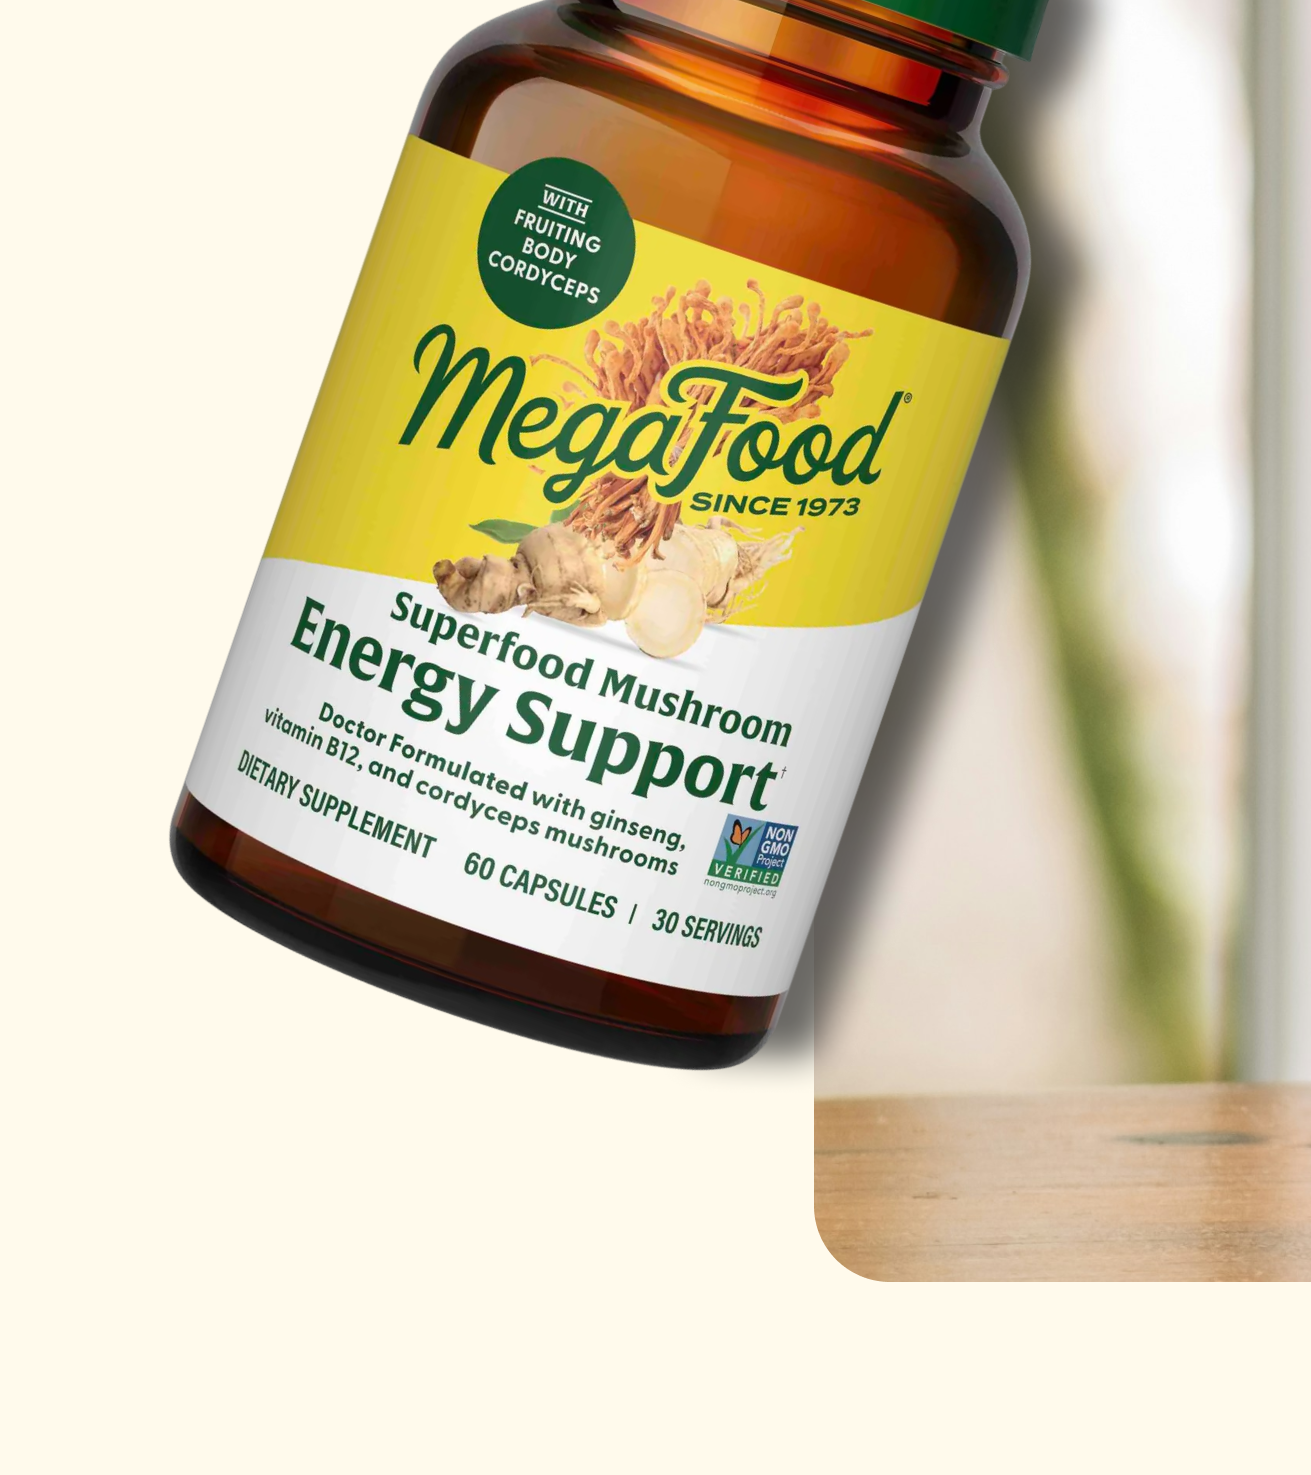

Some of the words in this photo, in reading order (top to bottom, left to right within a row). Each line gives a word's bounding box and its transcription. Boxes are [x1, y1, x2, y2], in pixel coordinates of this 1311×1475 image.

[542, 189, 589, 218] WITH
[514, 208, 601, 253] FRUITING
[522, 237, 577, 269] BODY
[488, 251, 601, 304] CORDYCEPS
[690, 492, 791, 516] SINCE
[796, 497, 861, 517] 1973
[290, 596, 500, 735] Energy
[390, 591, 595, 690] Superfood
[598, 667, 792, 747] Mushroom
[264, 707, 324, 751] vitamin
[325, 736, 363, 771] B12,
[368, 759, 415, 789] and
[416, 779, 541, 835] cordyceps
[544, 825, 679, 876] mushrooms
[318, 701, 387, 747] Doctor
[389, 733, 528, 801] Formulated
[532, 792, 586, 820] with
[589, 809, 686, 852] ginseng,
[237, 749, 301, 800] DIETARY
[299, 783, 438, 859] SUPPLEMENT
[760, 840, 790, 856] GMO
[765, 826, 795, 842] NON
[714, 862, 780, 885] VERIFIED
[756, 853, 785, 869] Project
[463, 851, 496, 880] 60
[499, 864, 618, 919] CAPSULES
[703, 878, 777, 899] nongmoproject.org
[652, 908, 680, 934] 30
[681, 915, 763, 948] SERVINGS
